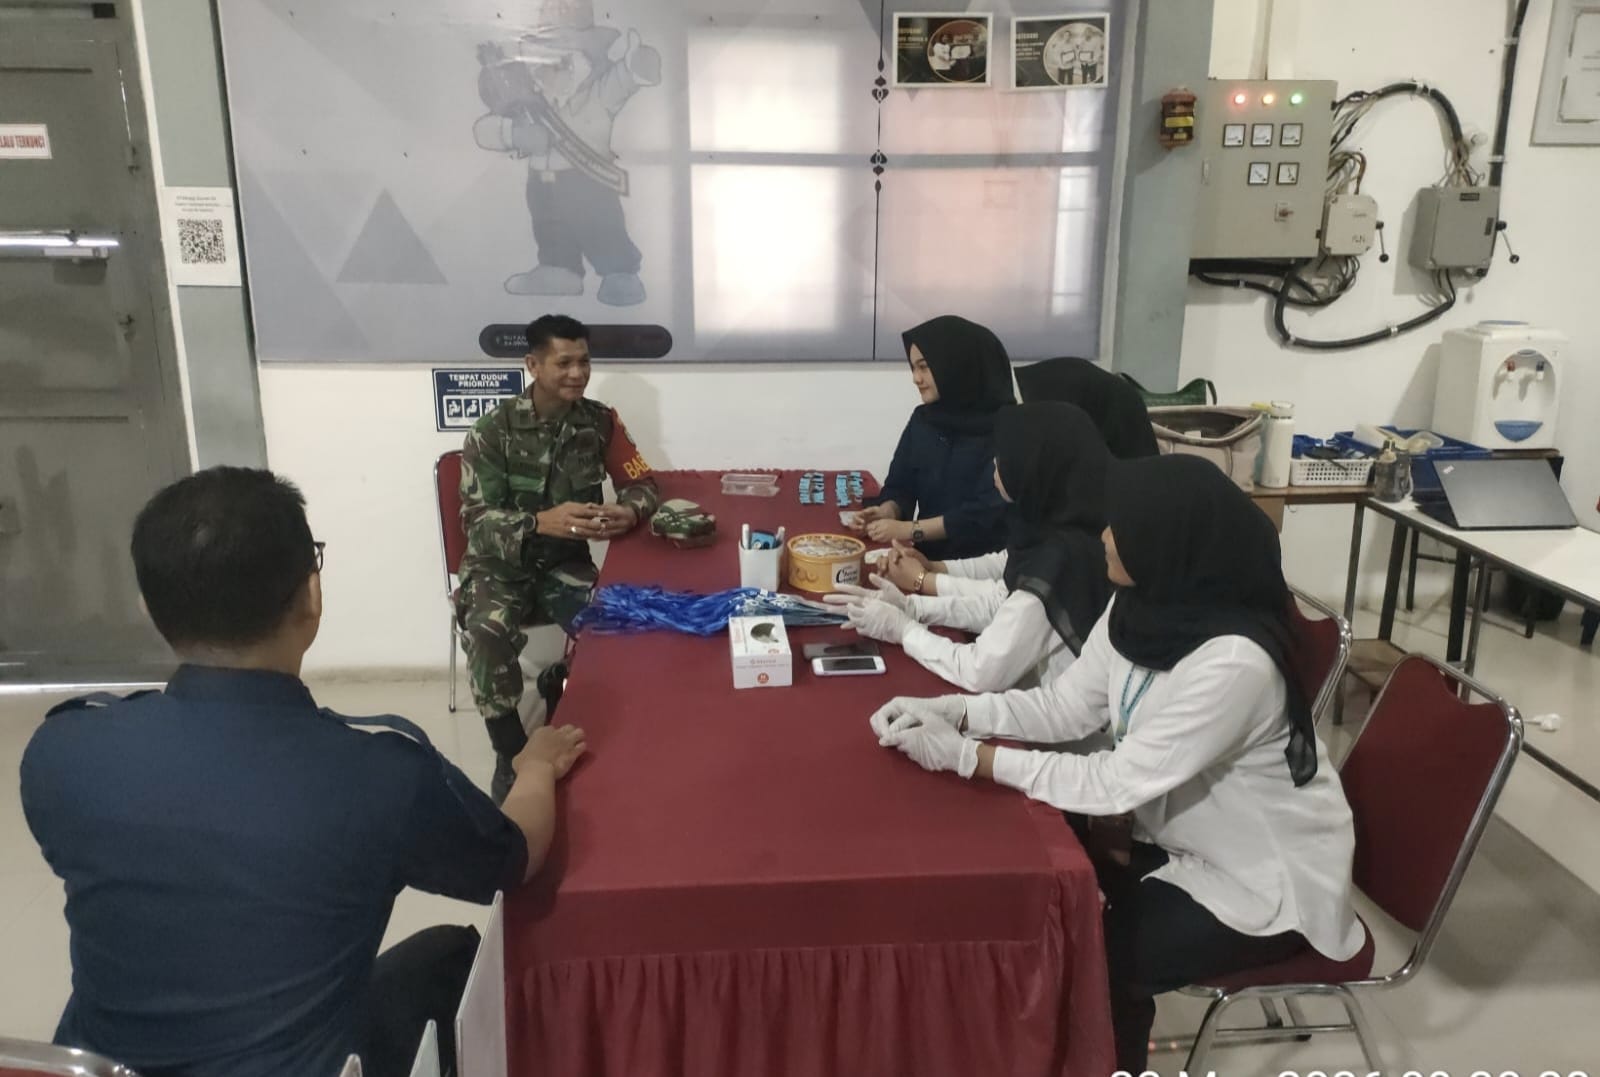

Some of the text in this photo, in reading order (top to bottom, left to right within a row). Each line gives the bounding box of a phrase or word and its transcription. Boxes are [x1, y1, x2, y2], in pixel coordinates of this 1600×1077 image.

[15, 135, 46, 149] TERKUNCI
[448, 373, 508, 381] TEMPAT DUDUK
[458, 380, 500, 388] PRIORITAS
